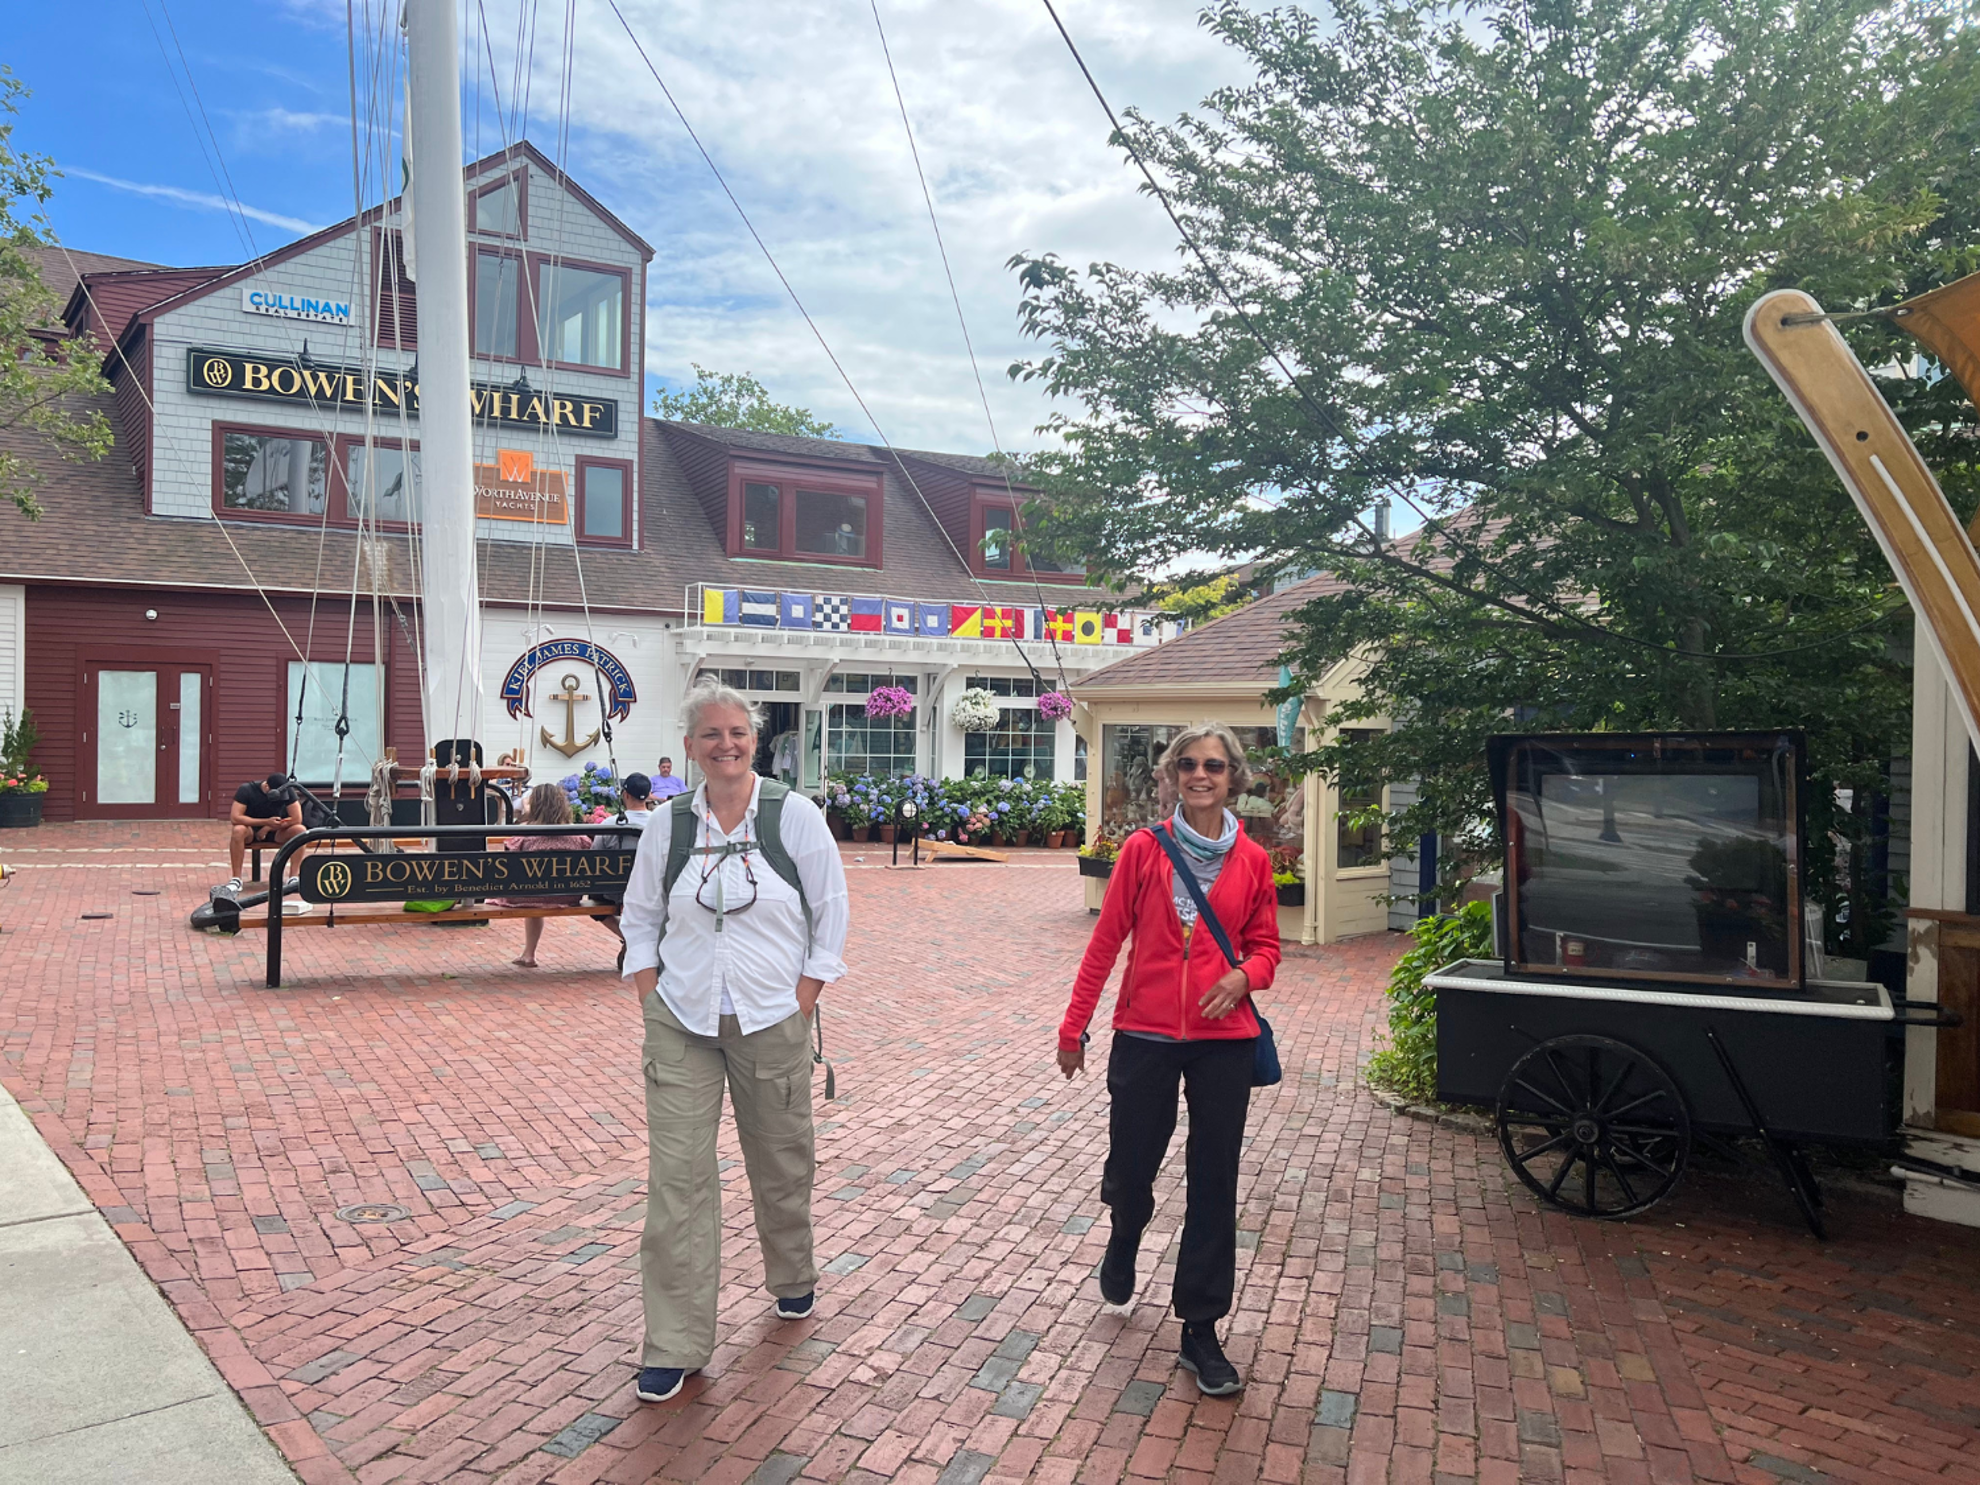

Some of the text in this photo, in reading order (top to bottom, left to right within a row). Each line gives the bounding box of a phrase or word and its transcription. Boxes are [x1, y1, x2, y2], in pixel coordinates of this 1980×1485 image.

[249, 291, 348, 317] CULLINAN
[255, 305, 343, 323] REAL ESTATE
[496, 500, 535, 511] YACHTS
[510, 643, 630, 693] KIEL JAMES PATRICK
[364, 855, 632, 883] BOWEN'S WHARF
[407, 885, 429, 894] Est.
[435, 884, 449, 894] by
[454, 882, 504, 892] Benedict
[509, 881, 549, 890] Arnold
[554, 881, 564, 889] in
